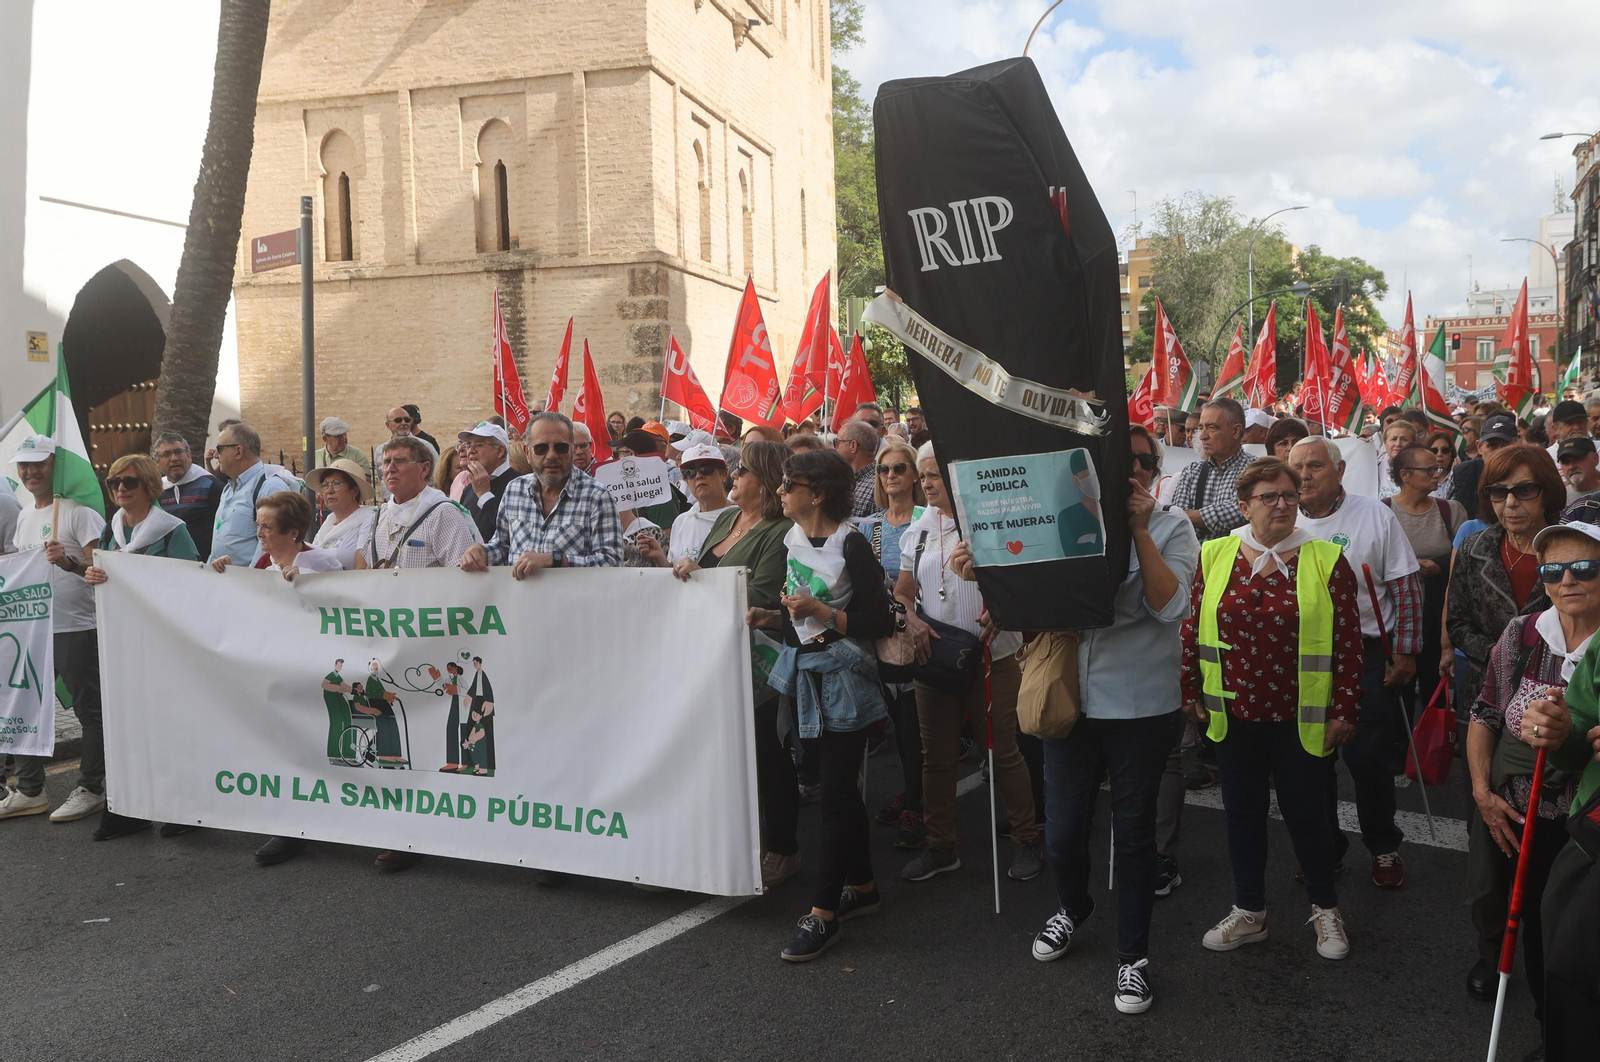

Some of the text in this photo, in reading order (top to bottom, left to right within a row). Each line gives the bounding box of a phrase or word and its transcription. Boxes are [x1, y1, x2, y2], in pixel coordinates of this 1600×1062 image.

[907, 195, 1014, 272] RIP
[904, 316, 1077, 420] HERRERA NO TE OLVIDA
[503, 386, 526, 424] Sevilla
[976, 466, 1027, 480] SANIDAD
[625, 480, 635, 488] la
[636, 475, 661, 487] salud
[979, 479, 1029, 493] PÚBLICA
[620, 493, 632, 502] se
[633, 486, 664, 502] juega!
[981, 496, 1034, 508] ERES NUESTRA
[977, 502, 1042, 516] RAZÓN PARA VIVIR
[972, 514, 1056, 533] ¡NO TE MUERAS!
[2, 592, 21, 603] DE
[319, 605, 507, 638] HERRERA
[216, 770, 629, 839] CON LA SANIDAD PÚBLICA
